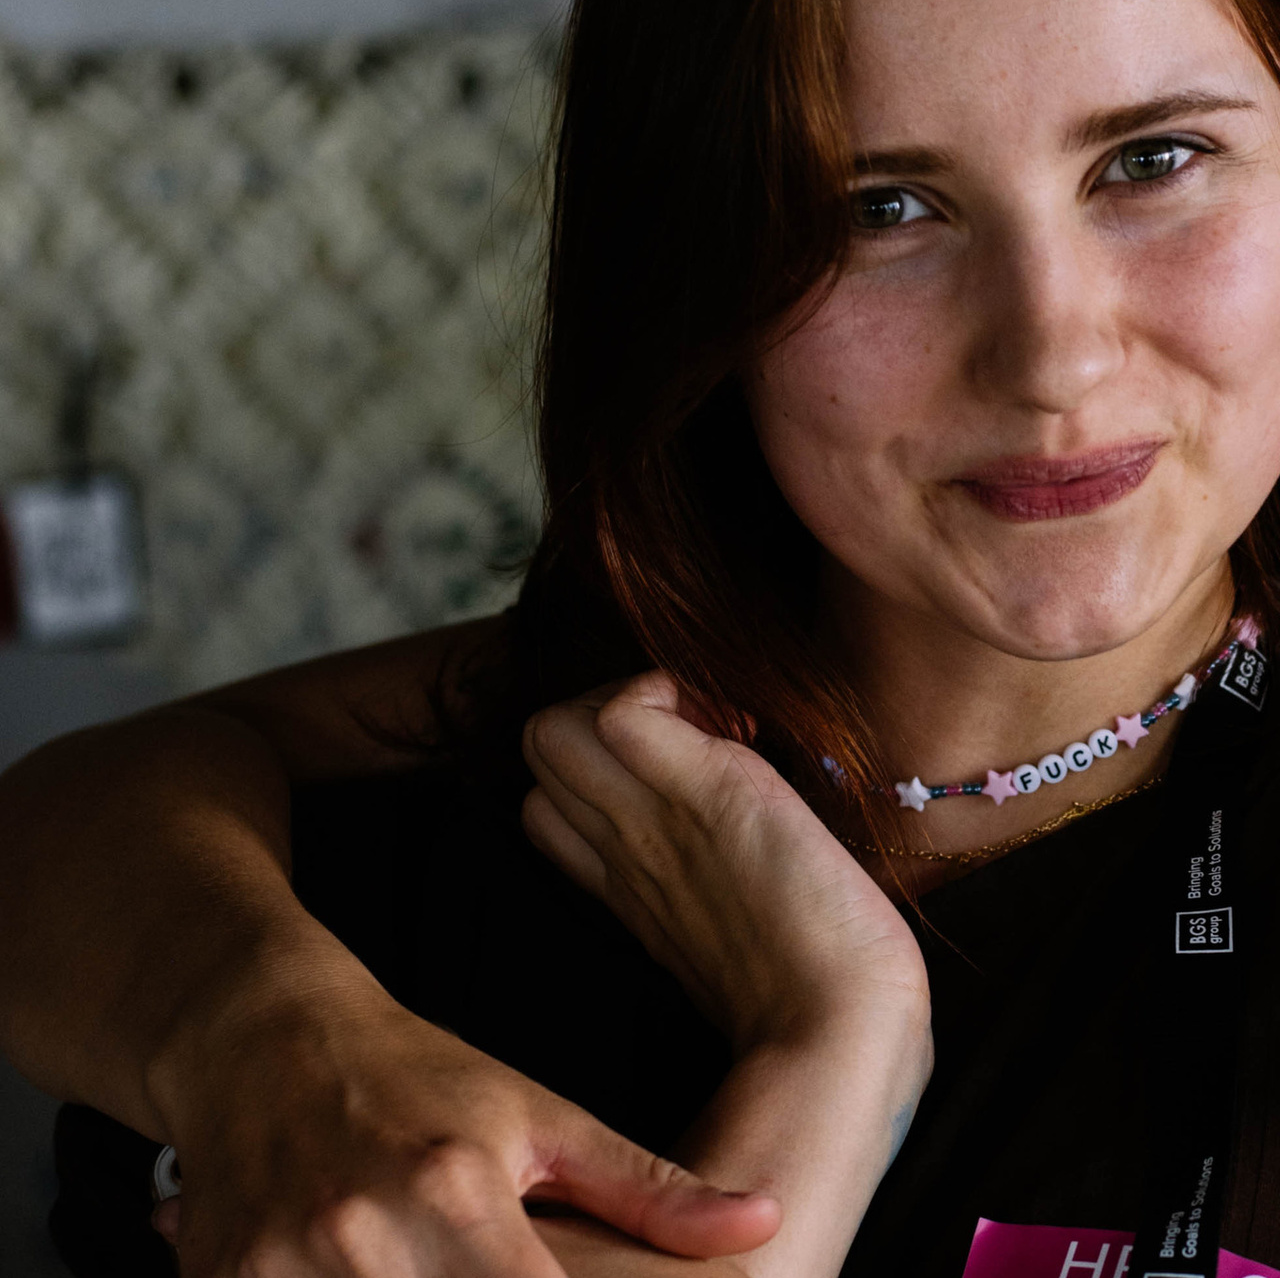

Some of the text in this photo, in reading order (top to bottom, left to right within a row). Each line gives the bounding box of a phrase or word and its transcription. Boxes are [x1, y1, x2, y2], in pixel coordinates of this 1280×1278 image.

[1235, 651, 1257, 688] BGS
[1250, 661, 1265, 696] group
[1019, 735, 1113, 791] FUCK
[1208, 810, 1223, 896] Goals to Solutions
[1188, 856, 1204, 899] Bringing
[1189, 917, 1207, 944] BGS
[1210, 915, 1223, 944] group
[1189, 1208, 1202, 1221] to
[1159, 1211, 1185, 1258] Bringing
[1181, 1222, 1200, 1258] Goals
